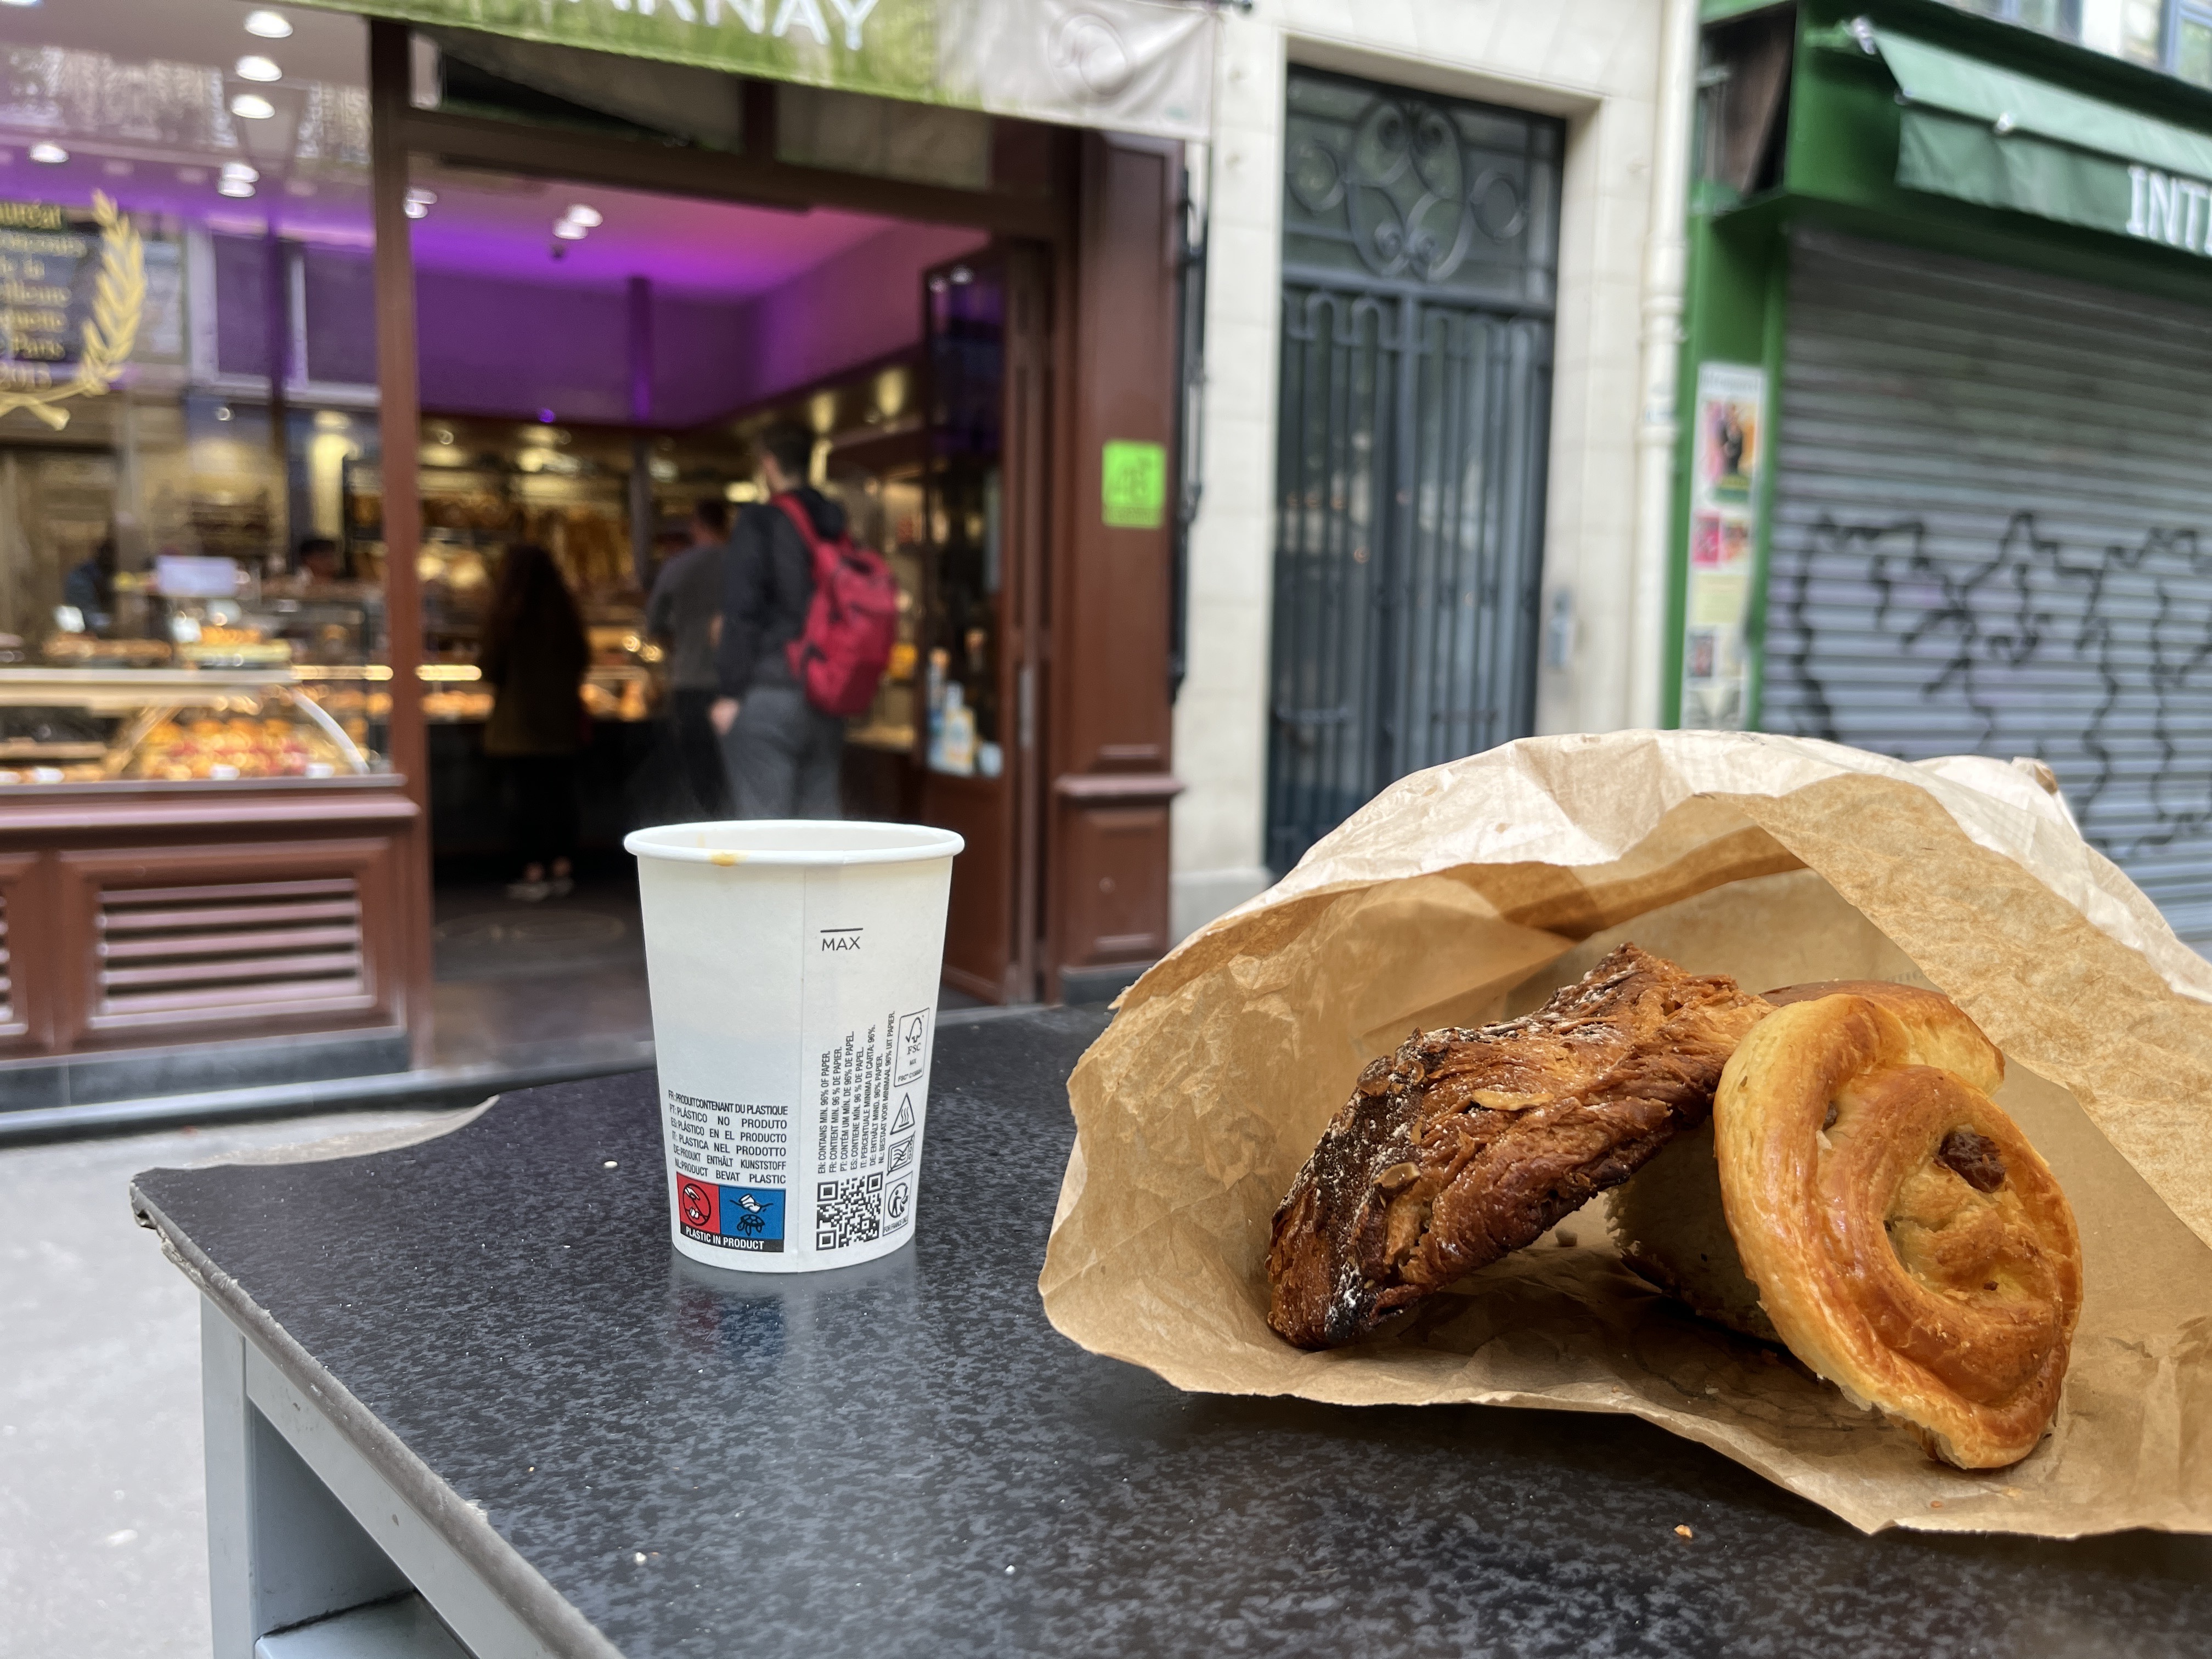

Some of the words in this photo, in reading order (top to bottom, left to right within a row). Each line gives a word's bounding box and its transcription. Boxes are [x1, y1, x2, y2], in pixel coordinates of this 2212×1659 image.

[822, 936, 861, 951] MAX
[907, 1042, 921, 1054] FSC
[821, 1051, 830, 1076] PAPER.
[833, 1047, 842, 1074] PAPIER.
[845, 1057, 853, 1067] DE
[866, 1045, 874, 1069] CARTA:
[821, 1078, 828, 1087] OF
[833, 1076, 840, 1085] DE
[855, 1073, 862, 1082] DE
[844, 1087, 851, 1096] DE
[854, 1093, 861, 1102] 96
[864, 1080, 872, 1107] MINIMA
[696, 1098, 734, 1113] CONTENANT
[735, 1104, 746, 1114] DU
[747, 1105, 788, 1115] PLASTIQUE
[832, 1097, 839, 1105] 96
[718, 1116, 730, 1126] NO
[742, 1119, 787, 1129] PRODUTO
[831, 1107, 839, 1123] MIN.
[842, 1116, 850, 1127] UM
[710, 1128, 719, 1138] EN
[725, 1131, 735, 1140] EL
[741, 1132, 787, 1143] PRODUCTO
[851, 1122, 860, 1157] CONTIENE
[861, 1109, 870, 1159] PERCENTUALE
[870, 1122, 878, 1153] ENTHÄLT
[679, 1134, 709, 1150] PLASTICA
[714, 1143, 730, 1153] NEL
[736, 1146, 786, 1156] PRODOTTO
[819, 1125, 827, 1160] CONTAINS
[830, 1125, 838, 1160] CONTIENT
[840, 1130, 849, 1159] CONTÉM
[707, 1155, 733, 1167] ENTHÄLT
[741, 1159, 786, 1170] KUNSTSTOFF
[681, 1160, 708, 1176] PRODUCT
[716, 1170, 740, 1181] BEVAT
[749, 1174, 786, 1184] PLASTIC
[686, 1226, 711, 1243] PLASTIC
[713, 1234, 721, 1245] IN
[723, 1237, 764, 1250] PRODUCT
